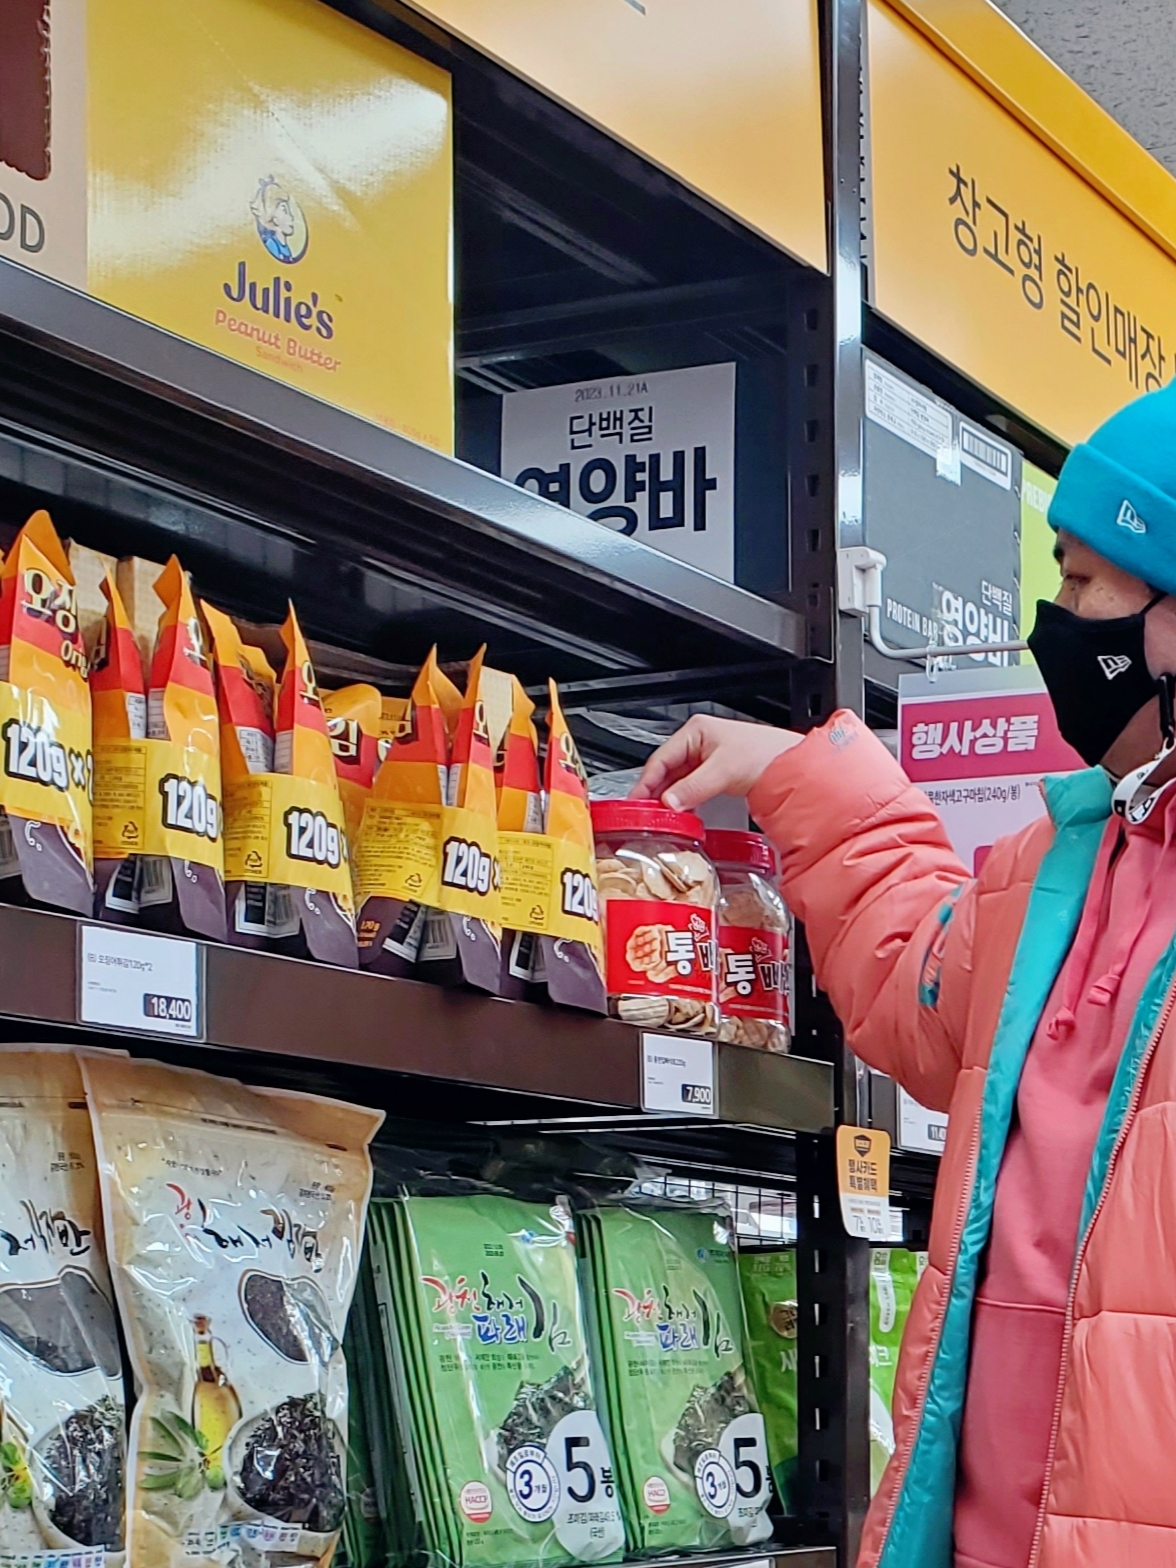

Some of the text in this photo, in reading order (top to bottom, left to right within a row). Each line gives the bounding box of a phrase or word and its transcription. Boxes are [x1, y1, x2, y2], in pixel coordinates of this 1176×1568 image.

[223, 260, 334, 340] Julie's
[948, 163, 1166, 392] 창고형 할인매장
[215, 309, 341, 372] Peanut Butter
[569, 405, 653, 450] 단백질
[887, 598, 920, 633] PROTEIN
[5, 722, 70, 789] 120g
[911, 714, 1039, 760] 행사상품
[163, 777, 219, 838] 120g
[288, 809, 339, 866] 120g
[445, 840, 490, 893] 120g
[151, 996, 190, 1020] 18,400
[685, 1086, 711, 1103] 7,900
[519, 1469, 533, 1500] 3
[564, 1436, 596, 1503] 5
[706, 1471, 717, 1500] 3
[733, 1437, 762, 1499] 5
